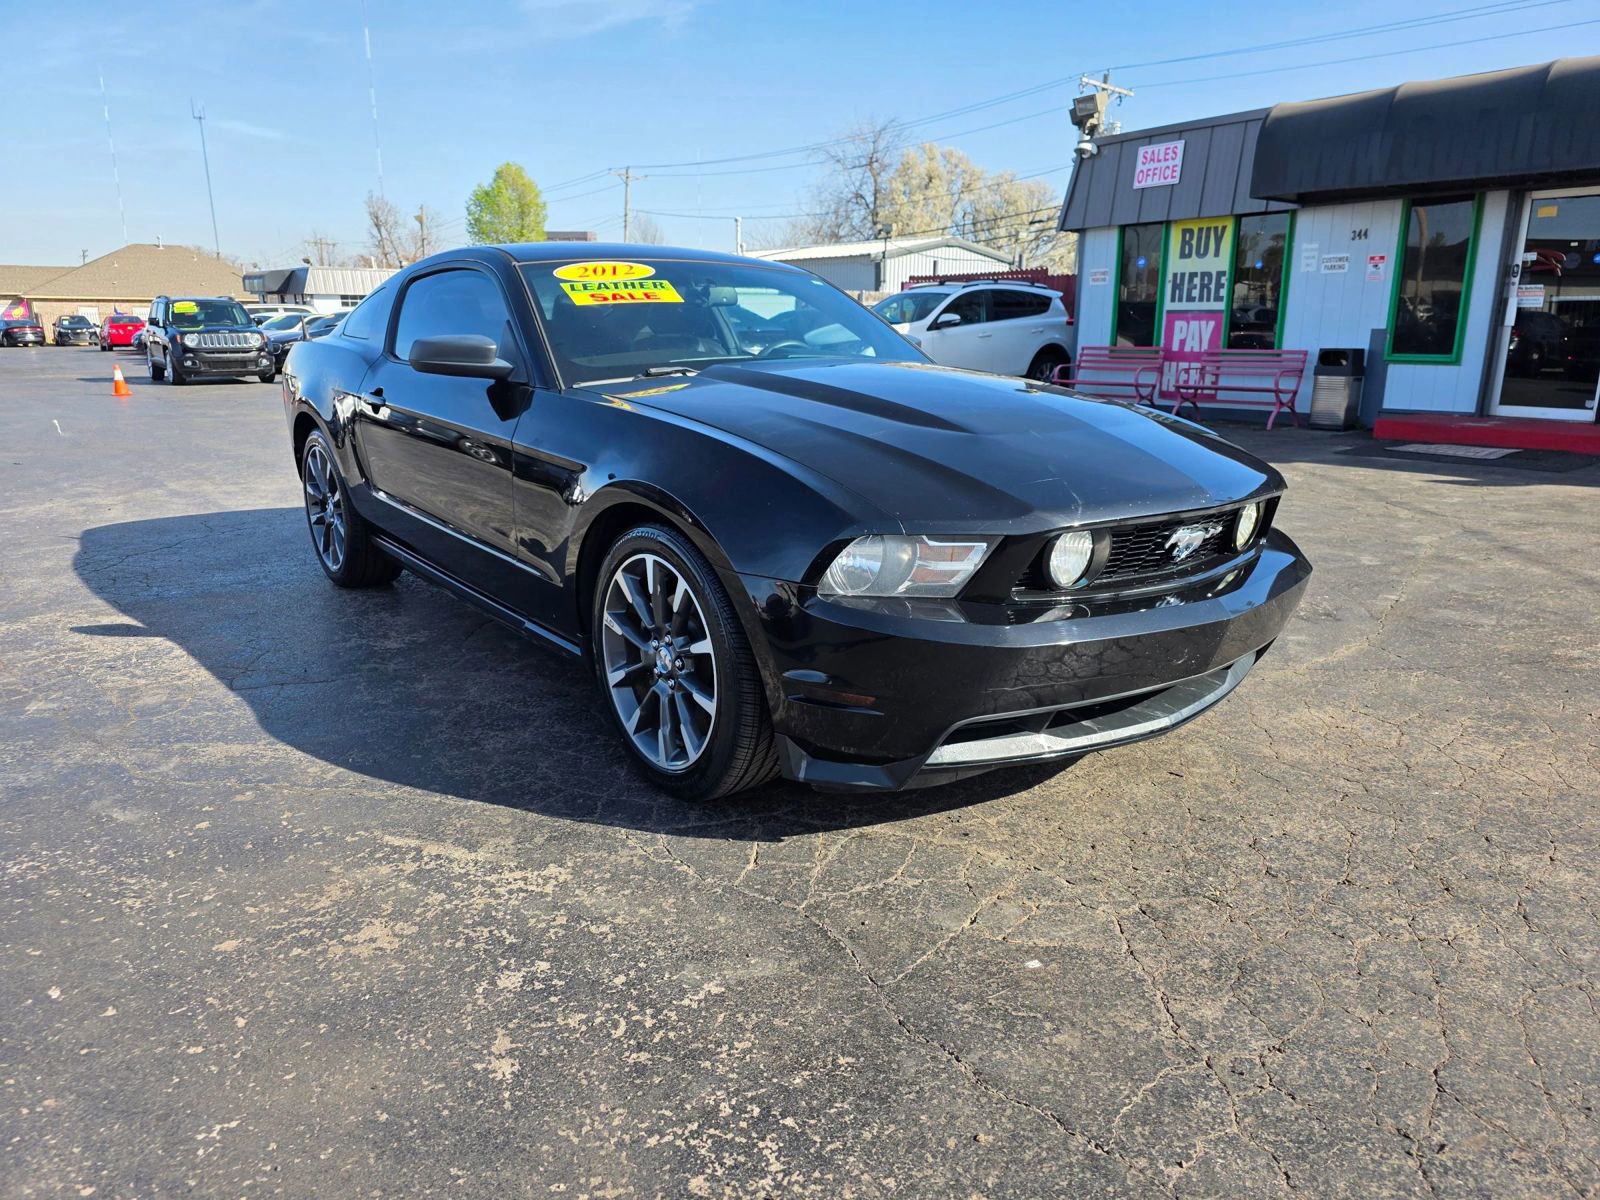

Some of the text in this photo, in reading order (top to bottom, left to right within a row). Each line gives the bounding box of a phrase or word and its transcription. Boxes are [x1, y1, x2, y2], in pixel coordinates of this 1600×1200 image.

[1141, 145, 1178, 166] SALES
[1136, 164, 1178, 184] OFFICE
[1180, 225, 1227, 259] BUY
[1351, 228, 1369, 241] 344
[577, 264, 635, 278] 2012
[570, 281, 665, 292] LEATHER
[1170, 270, 1226, 303] HERE
[589, 292, 661, 303] SALE
[1172, 320, 1215, 351] PAY
